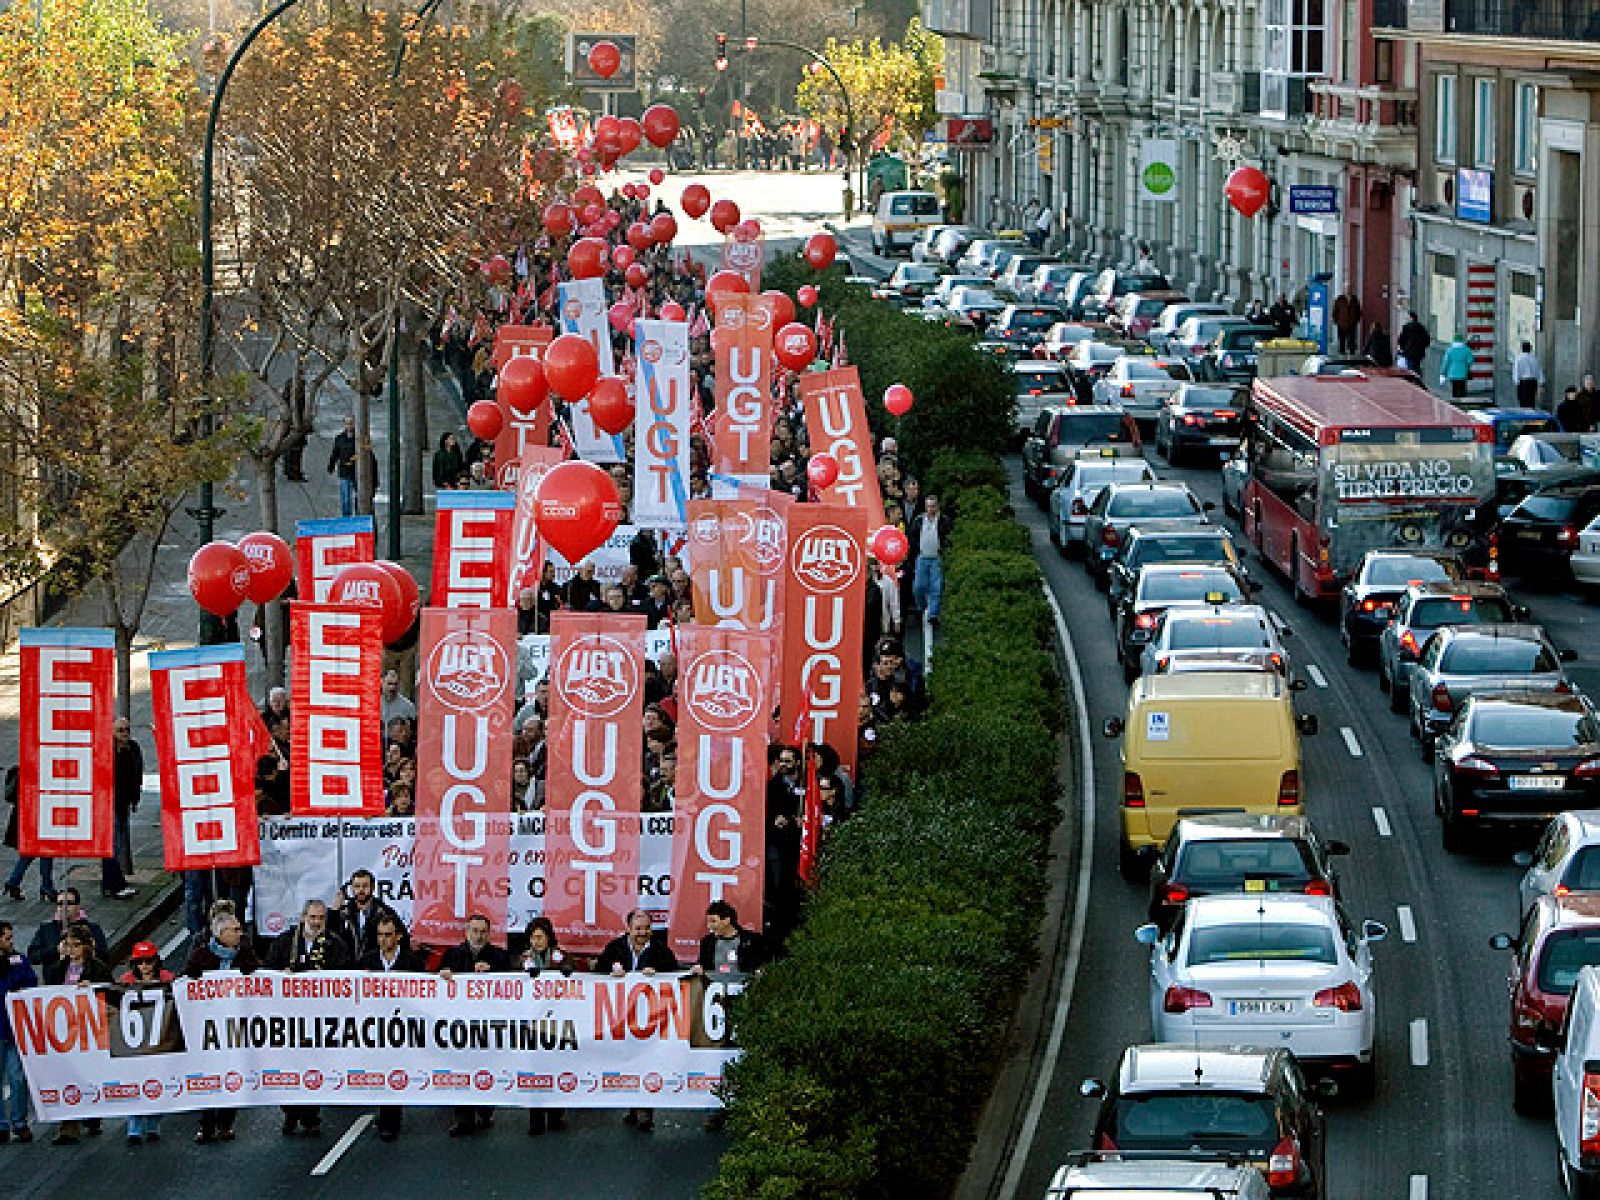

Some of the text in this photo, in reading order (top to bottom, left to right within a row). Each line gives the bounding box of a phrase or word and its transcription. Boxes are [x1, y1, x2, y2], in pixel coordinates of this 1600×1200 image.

[728, 346, 762, 462] UGT
[646, 377, 680, 503] UGT
[818, 391, 864, 507] UGT
[1364, 461, 1415, 479] VIDA
[1419, 459, 1451, 476] NO
[1335, 475, 1473, 498] TIENE PRECIO
[801, 538, 851, 563] UGT
[342, 580, 380, 601] UGT
[439, 644, 497, 675] UGT
[568, 650, 624, 681] UGT
[694, 664, 752, 692] UGT
[802, 597, 843, 745] UGT
[310, 612, 364, 808] CCOO
[39, 648, 93, 840] CCOO
[169, 664, 237, 856] CCOO
[439, 714, 488, 919] UGT
[570, 719, 618, 926] UGT
[694, 734, 743, 903] UGT
[564, 874, 676, 900] CSTRO
[187, 976, 273, 1001] RECUPERAR
[281, 977, 352, 999] DEREITOS
[361, 977, 437, 998] DEFENDER
[466, 979, 523, 999] ESTADO
[531, 979, 586, 1001] SOCIAL
[593, 981, 690, 1041] NON
[12, 989, 165, 1056] NON 67
[202, 1007, 578, 1051] A MOBILIZACIÓN CONTINÚA
